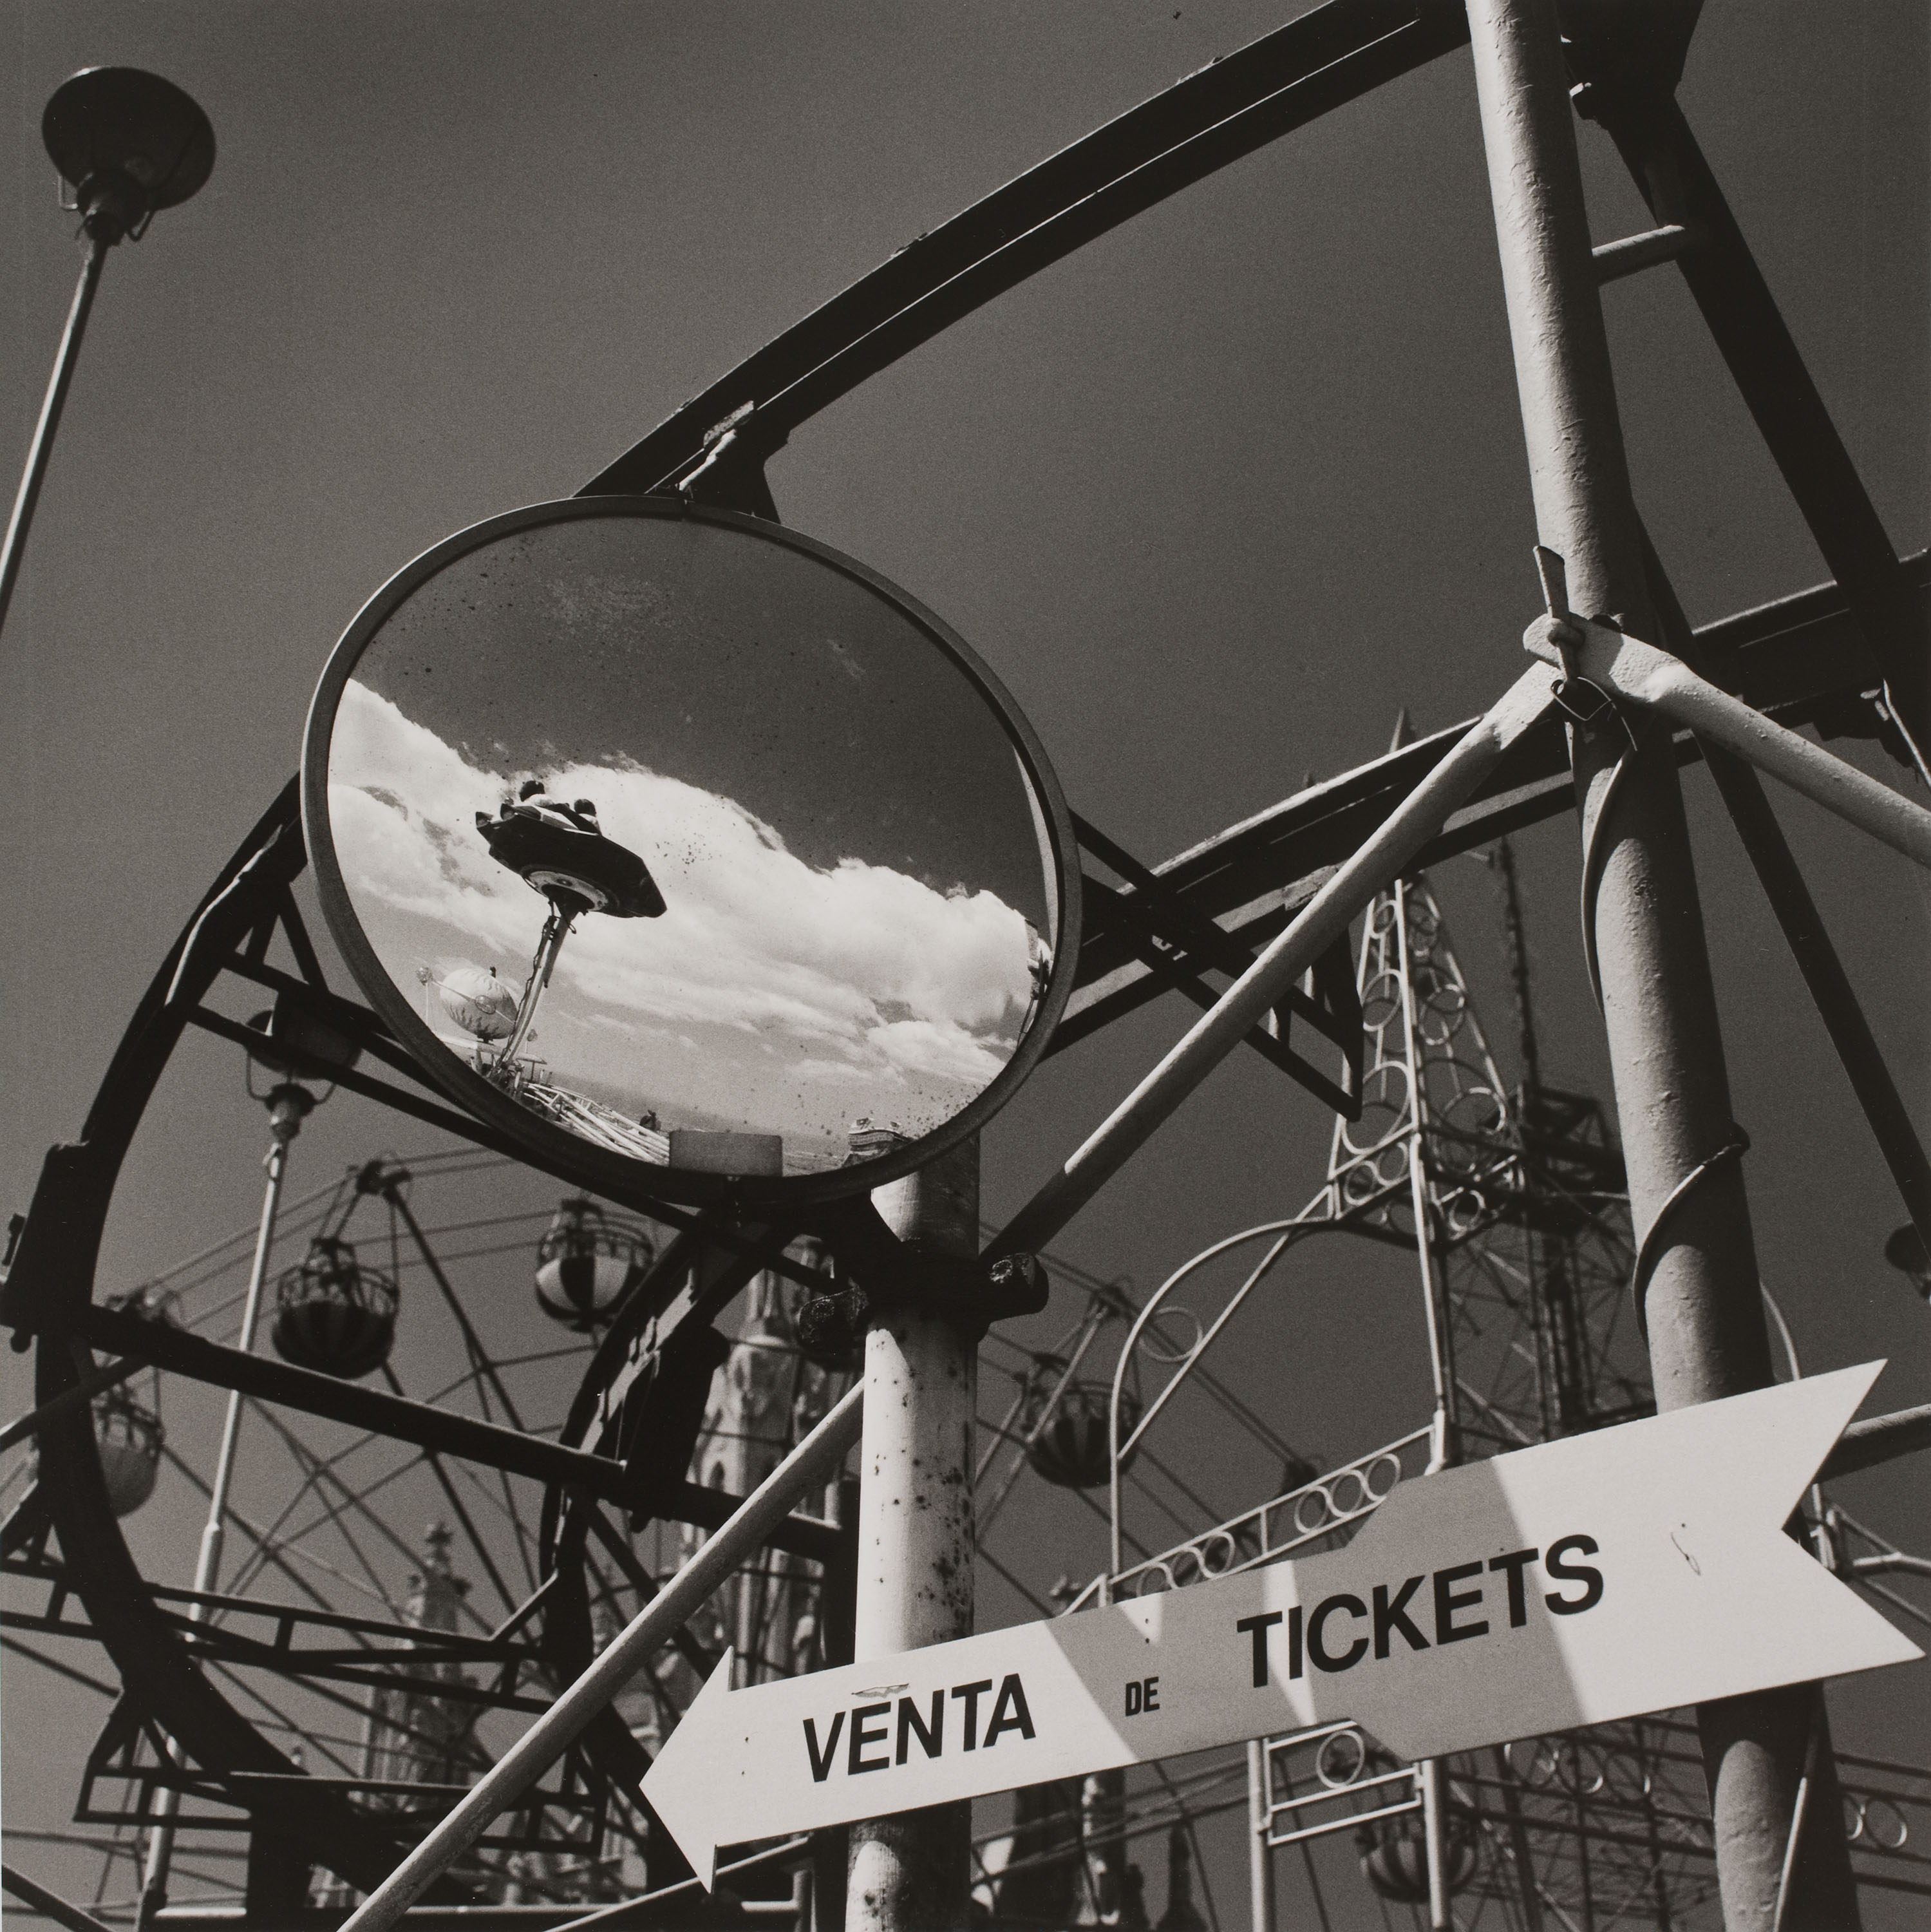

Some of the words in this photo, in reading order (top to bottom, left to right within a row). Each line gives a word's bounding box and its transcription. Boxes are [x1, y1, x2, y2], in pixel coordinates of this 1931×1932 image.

[803, 1673, 1036, 1783] VENTA
[1125, 1676, 1160, 1717] DE
[1236, 1535, 1603, 1689] TICKETS
